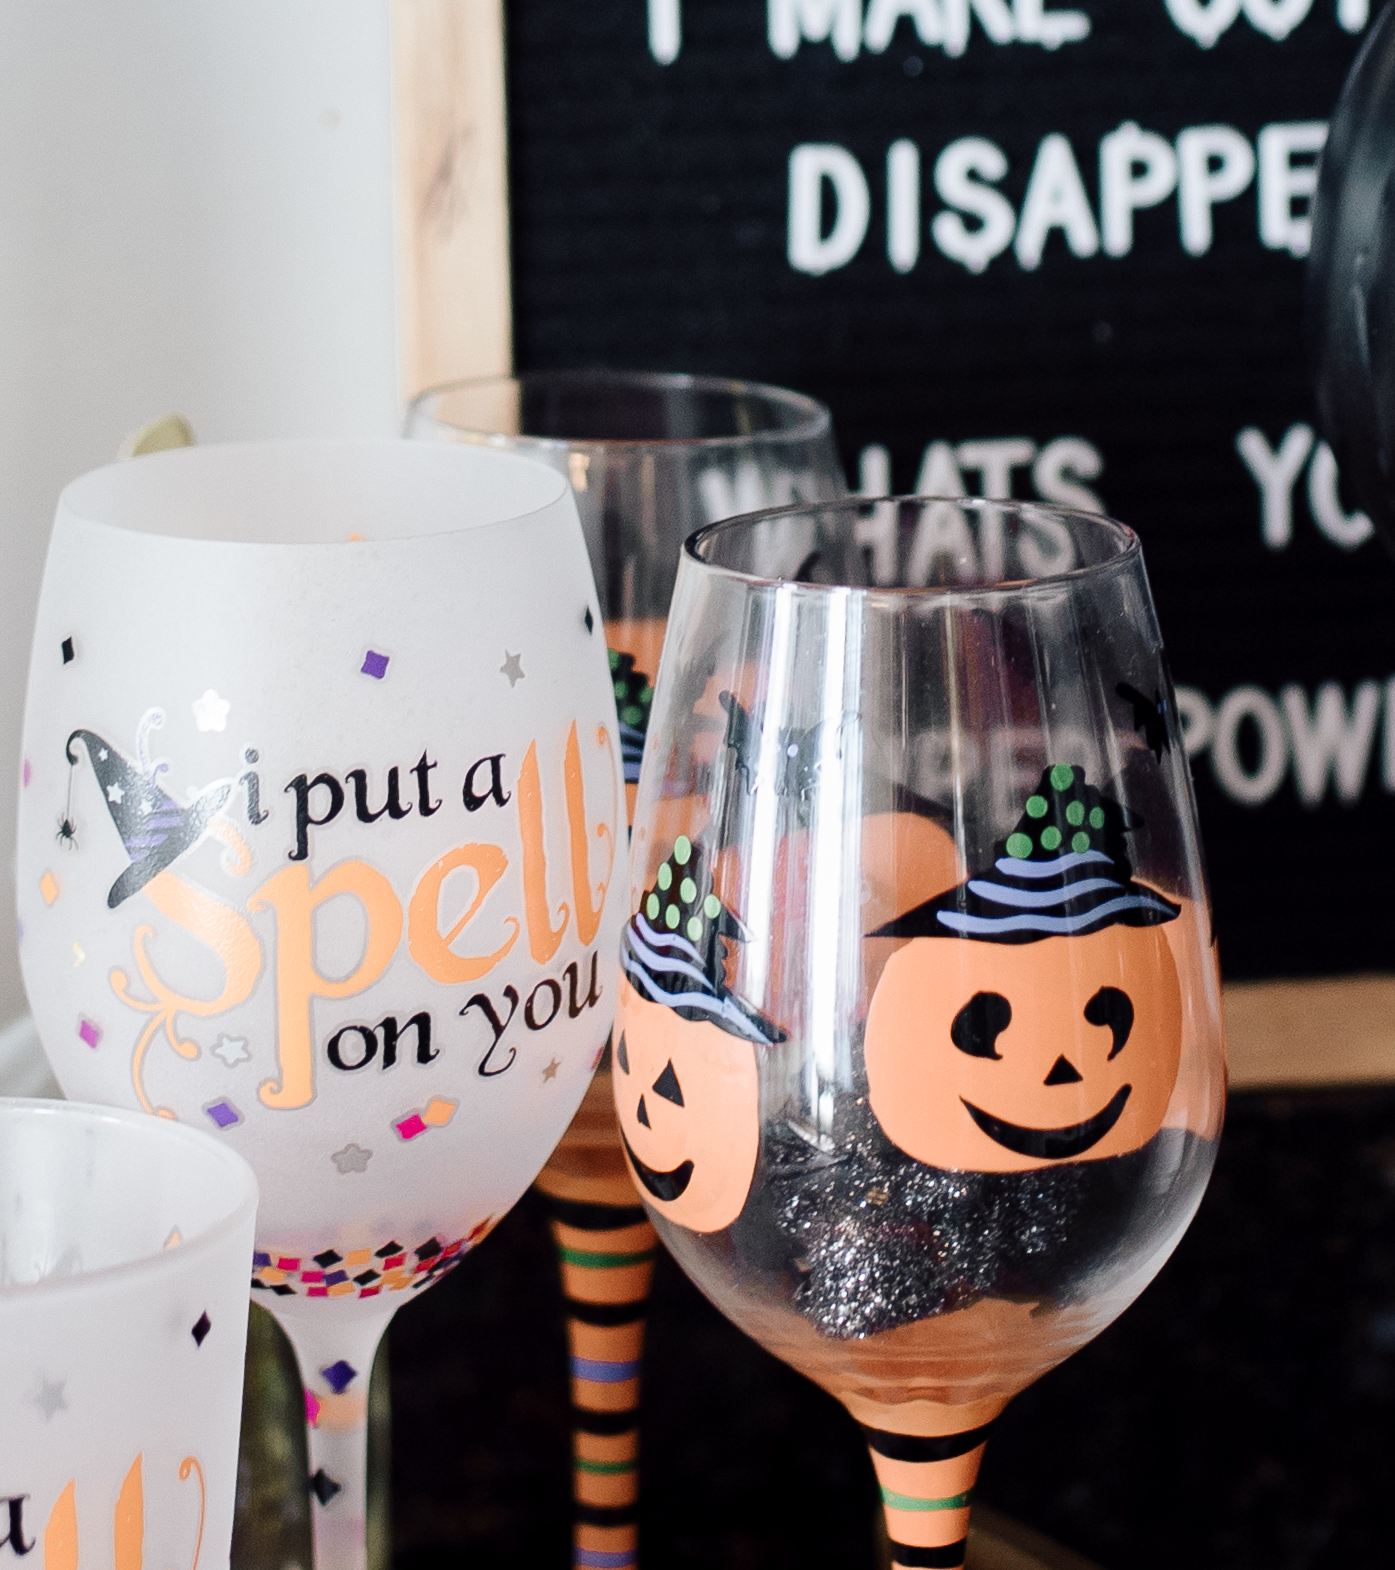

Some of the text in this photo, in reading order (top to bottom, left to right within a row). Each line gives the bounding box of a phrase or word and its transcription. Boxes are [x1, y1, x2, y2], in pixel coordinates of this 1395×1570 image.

[786, 120, 1331, 275] DISAPPE
[283, 749, 443, 861] put
[460, 752, 512, 811] a
[109, 718, 611, 1118] Spell
[326, 949, 603, 1077] on you
